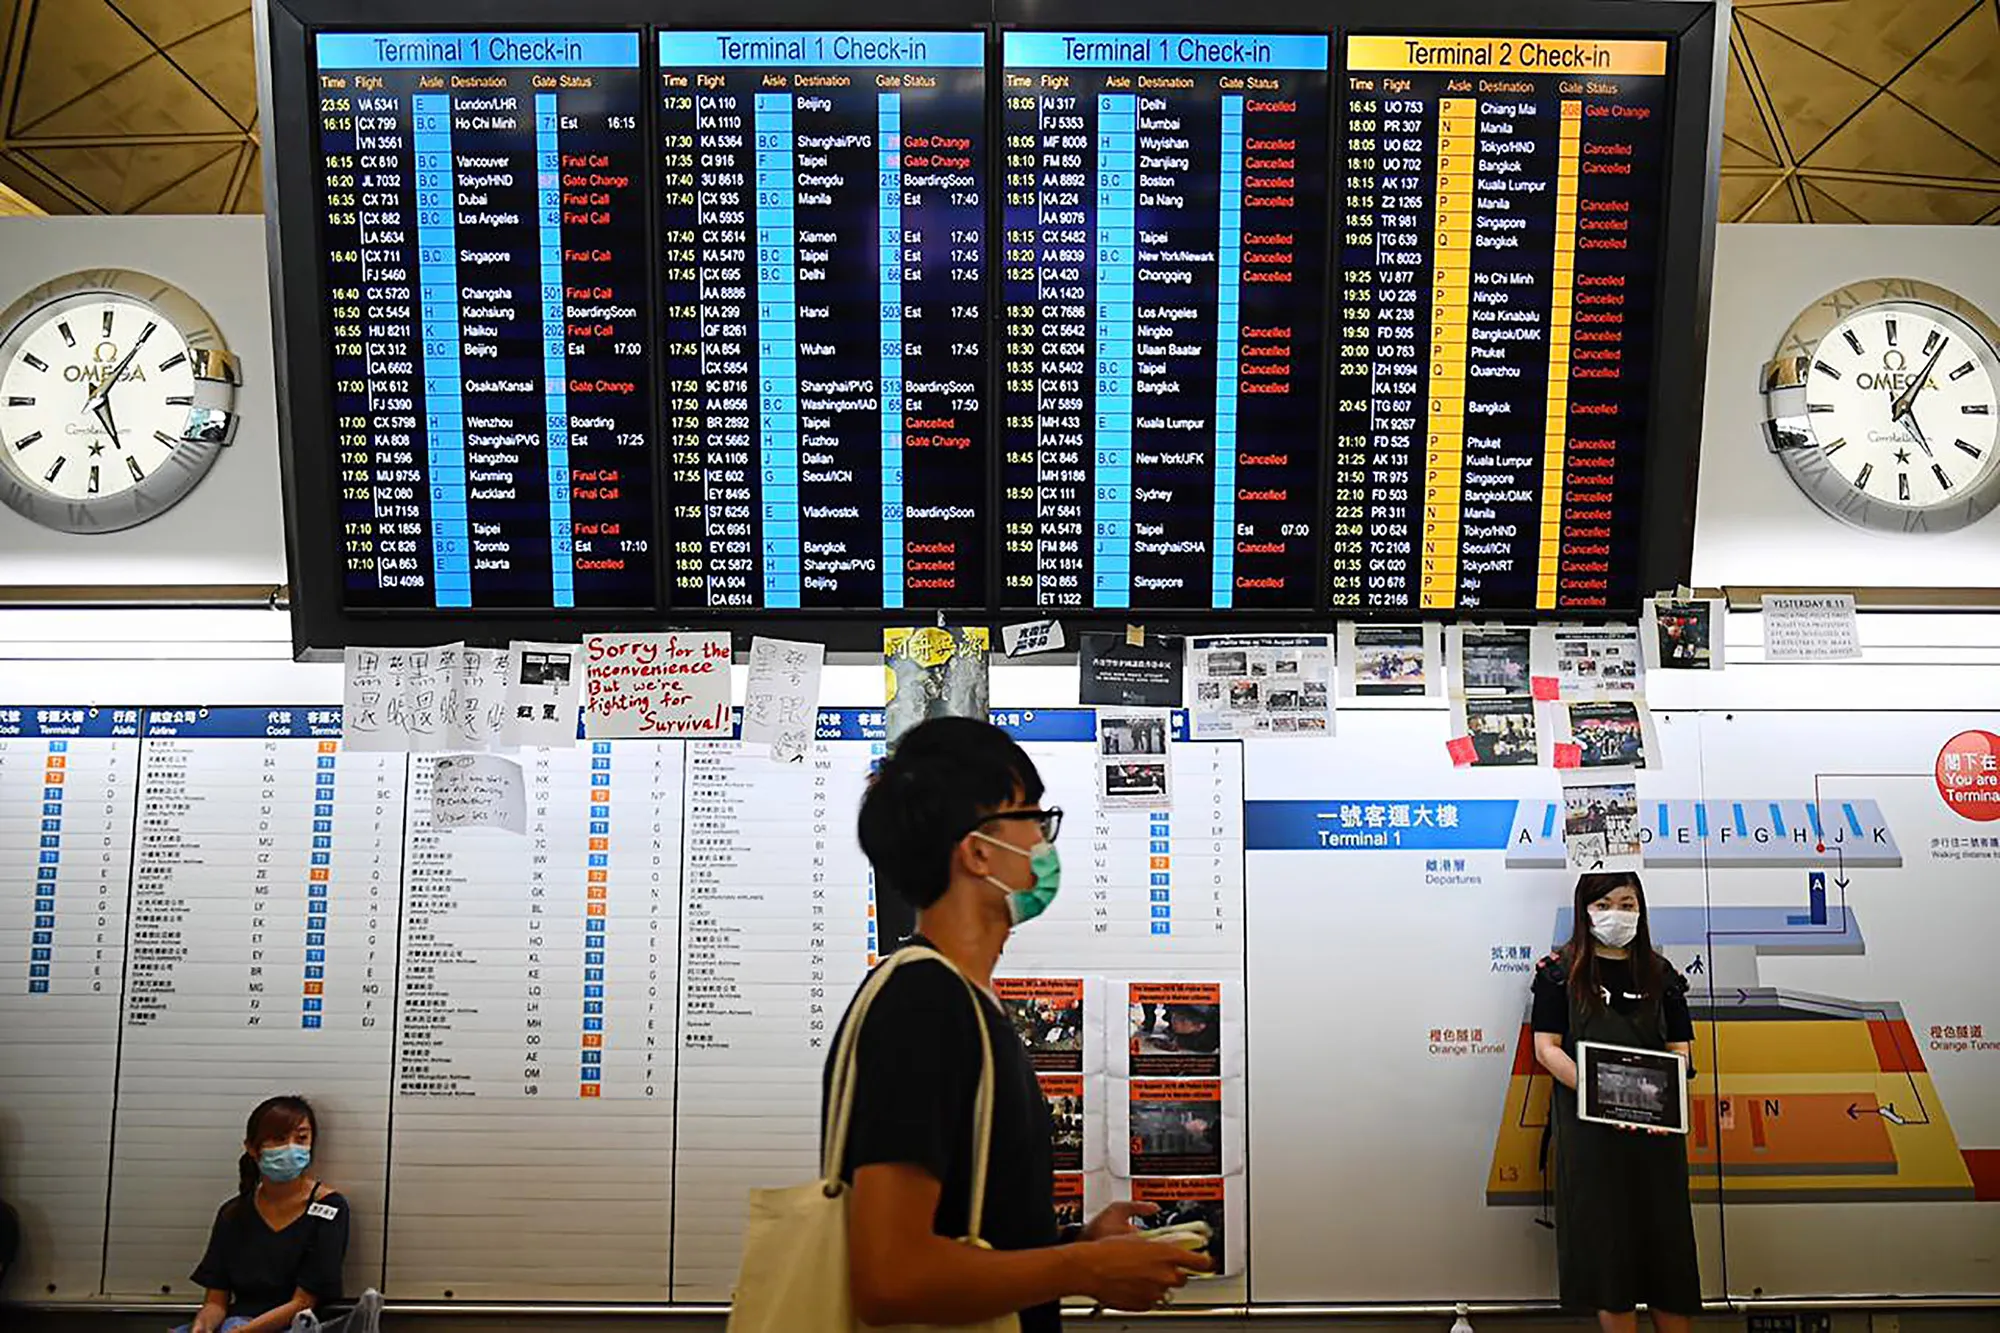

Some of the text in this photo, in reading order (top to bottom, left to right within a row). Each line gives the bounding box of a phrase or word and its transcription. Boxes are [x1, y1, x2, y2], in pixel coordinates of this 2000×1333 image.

[374, 38, 582, 62] Terminal 1 Check-in
[717, 37, 926, 60] Terminal 1 Check-in
[1063, 37, 1270, 62] Terminal 1 Check-in
[1405, 42, 1610, 67] Terminal 2 Check-in
[321, 76, 592, 89] Time Flight Aisle Destination Gate Status
[663, 75, 935, 88] Time Flight Aisle Destination Gate Status
[1007, 75, 1279, 88] Time Flight Aisle Destination Gate Status
[1350, 78, 1618, 94] Time Flight Aisle Destination Gate Status
[1350, 101, 1650, 118] 16:45 UO 753 Chiang Mai Gate Change
[324, 117, 635, 130] 16:15 CX 799 Ho Chi Minh Est 16:15
[326, 155, 608, 168] 16:15 CX 810 Vancouver Final Call
[666, 154, 970, 169] 17:35 CI 916 Taipei Gate Change
[666, 174, 693, 186] 17:40
[701, 174, 716, 186] 3U
[798, 174, 843, 186] Chengdu
[904, 174, 974, 188] BoardingSoon
[1007, 174, 1294, 188] 18:15 Boston Cancelled
[1336, 506, 1611, 519] 22:25 PR 311 Manila Cancelled
[1007, 523, 1033, 534] 18:50
[1041, 523, 1056, 534] KA
[1135, 523, 1163, 536] Taipei
[1238, 524, 1253, 535] Est
[1281, 524, 1309, 536] 07:00
[346, 541, 372, 552] 17:10
[381, 541, 396, 552] CX
[474, 541, 509, 552] Toronto
[575, 540, 591, 552] Est
[621, 540, 647, 551] 17:10
[676, 541, 954, 555] 18:00 EY 6291 Bangkok Cancelled
[588, 636, 730, 664] Sorry for the
[587, 662, 714, 678] inconvenience
[588, 679, 683, 695] But we're
[587, 692, 693, 717] fighting for
[639, 703, 730, 733] Survival!
[1946, 773, 1997, 785] You are
[1317, 804, 1459, 828] 一號客運大樓
[1319, 831, 1401, 847] Terminal 1
[1518, 828, 1532, 843] A
[1678, 828, 1886, 843] E F G H J K
[1426, 874, 1481, 885] Departures
[1812, 879, 1822, 890] A
[1490, 962, 1530, 972] Arrivals
[1429, 1044, 1505, 1055] Orange Tunnel
[1930, 1041, 1967, 1052] Orange
[1720, 1100, 1779, 1118] P N
